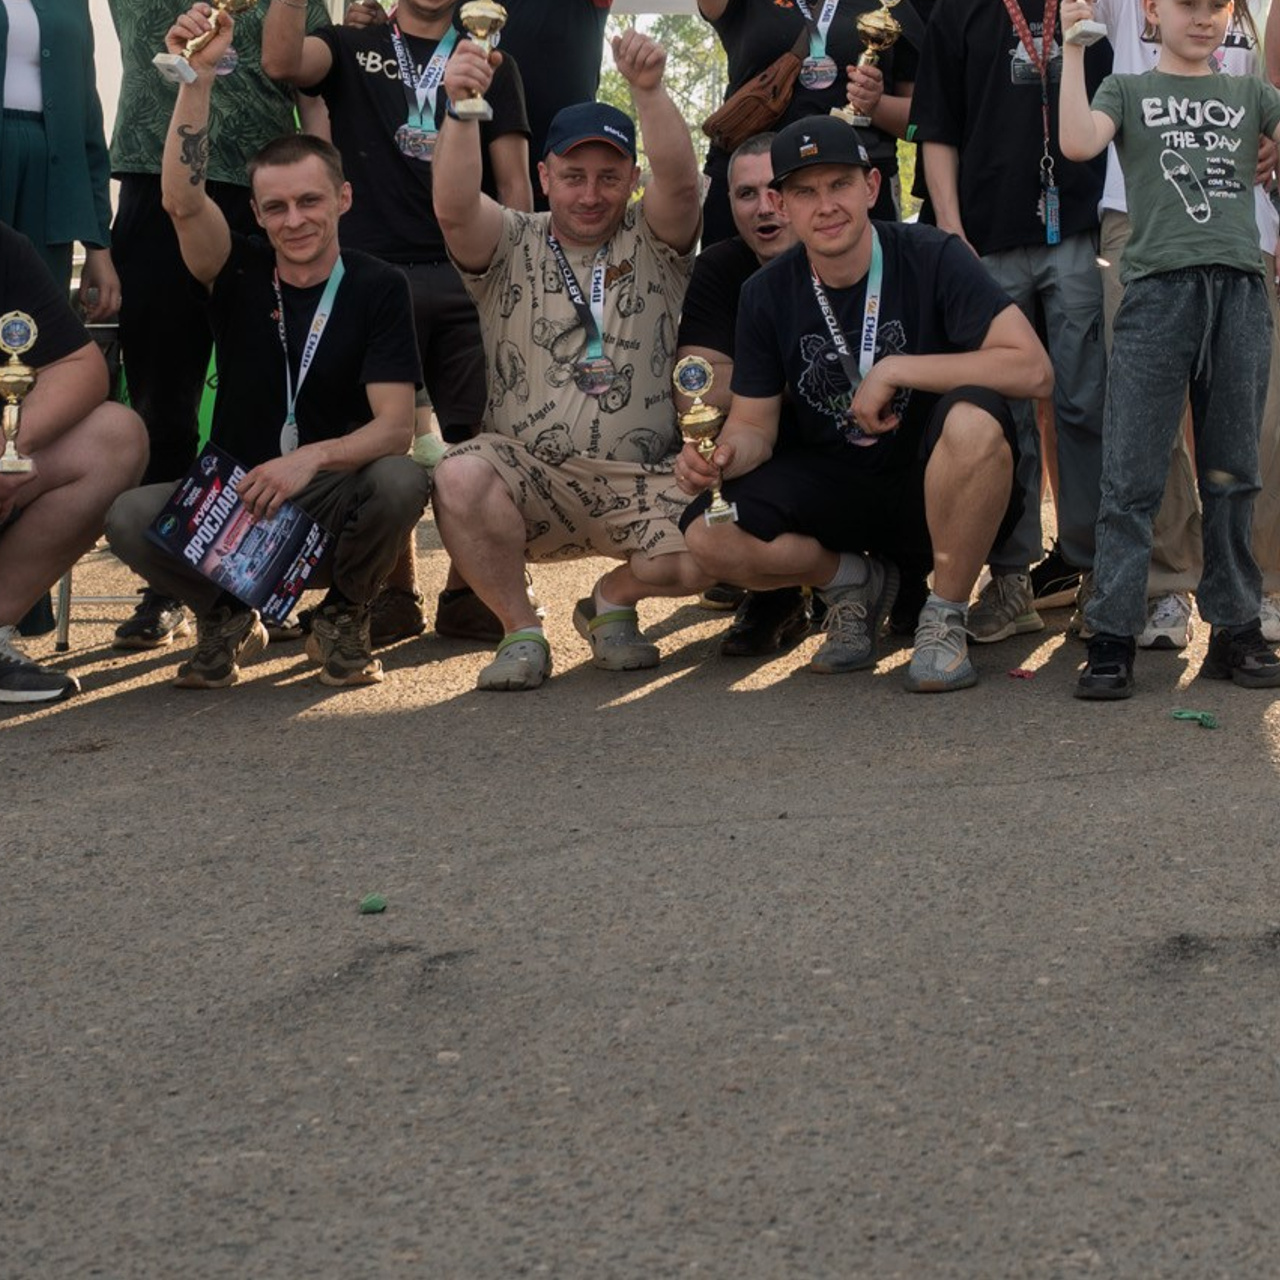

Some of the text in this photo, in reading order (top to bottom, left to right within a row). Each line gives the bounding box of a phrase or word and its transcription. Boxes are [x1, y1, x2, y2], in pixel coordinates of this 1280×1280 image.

[1142, 95, 1246, 129] ENJOY
[1161, 130, 1242, 152] THE DAY
[549, 233, 587, 307] АВТОЗВУК
[591, 270, 607, 304] ПРИЗ
[811, 276, 850, 356] АВТОЗВУК
[862, 316, 876, 353] ПРИЗ
[183, 465, 248, 565] ЯРОСЛАВЛЯ
[192, 485, 221, 526] КУБОК
